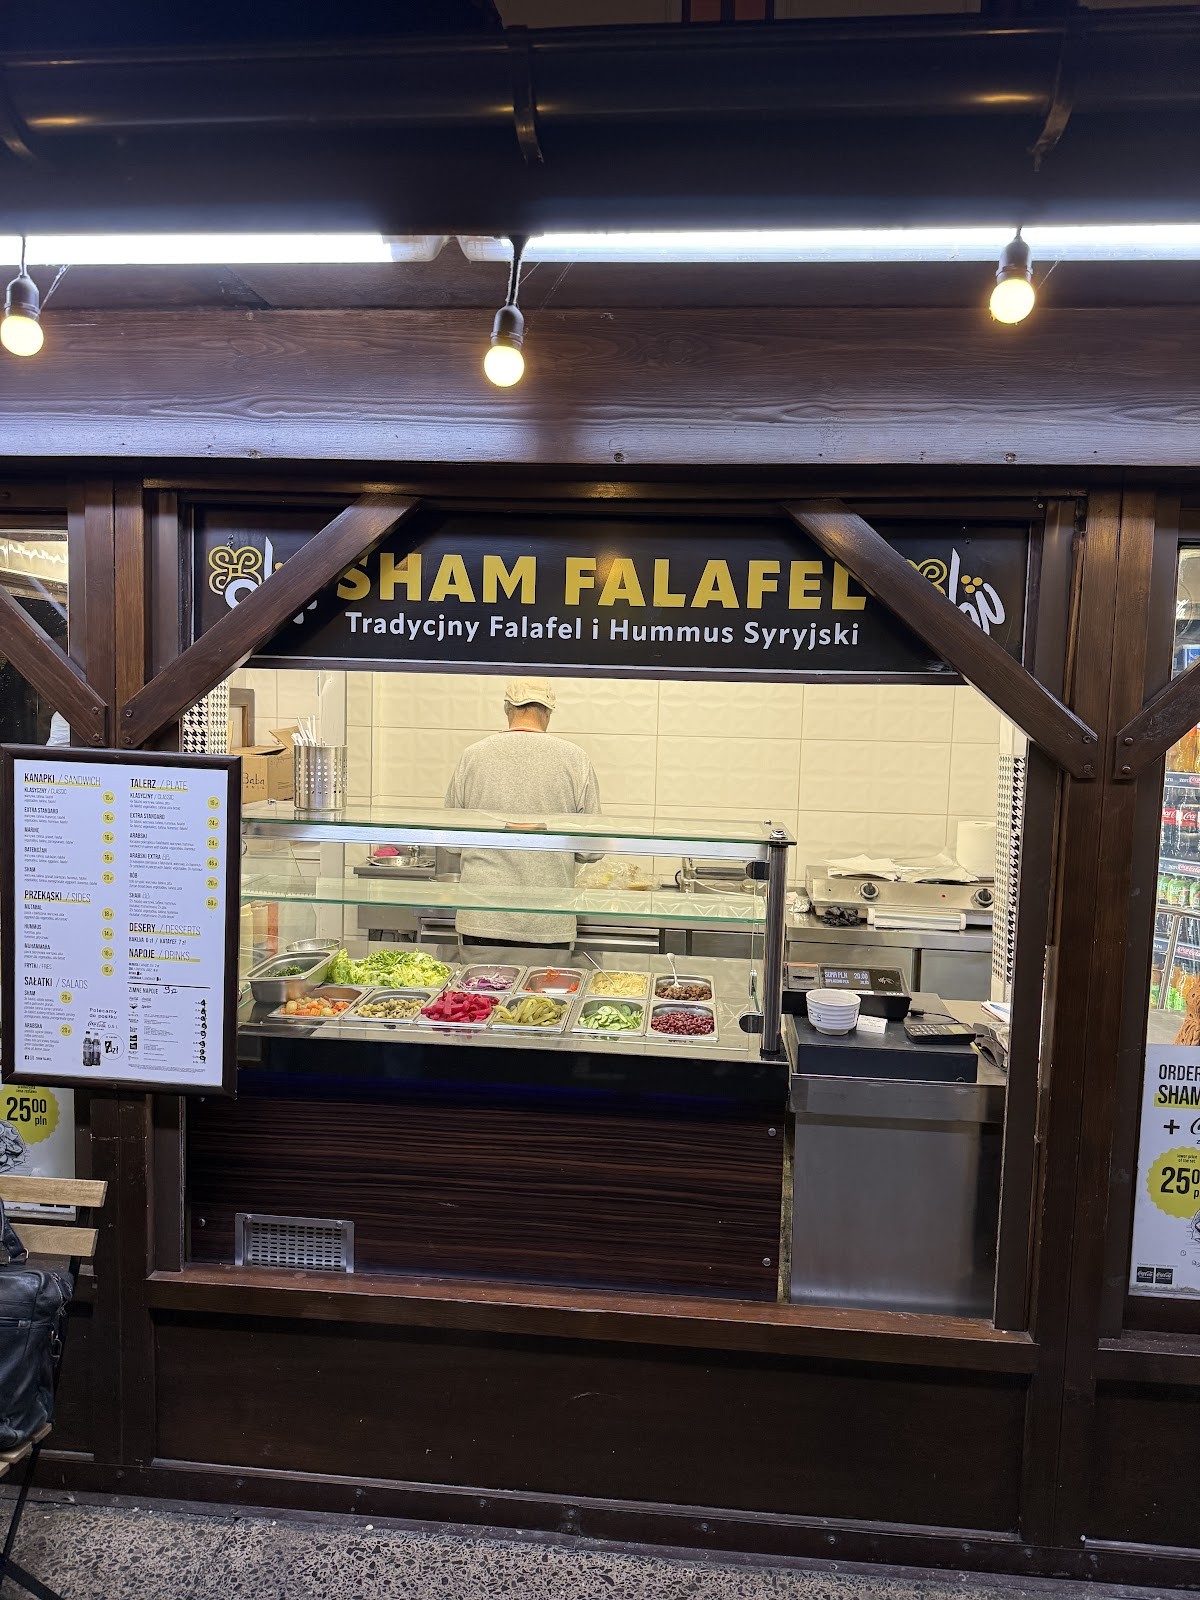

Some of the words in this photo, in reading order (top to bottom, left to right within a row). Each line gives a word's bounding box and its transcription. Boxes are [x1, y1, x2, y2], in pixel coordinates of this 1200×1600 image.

[337, 553, 536, 604] SHAM
[564, 556, 867, 611] FALAFEL
[345, 612, 479, 643] Tradycjny
[490, 615, 582, 640] Falafel
[591, 619, 599, 640] i
[609, 618, 734, 643] Hummus
[743, 622, 859, 651] Syryjski
[24, 772, 55, 784] KANAPKI
[64, 775, 101, 786] SANDWICH
[130, 778, 156, 788] TALERZ
[166, 780, 188, 790] PLATE
[24, 890, 62, 902] PRZEKĄSKI
[71, 893, 91, 903] SIDES
[129, 923, 156, 933] DESERY
[166, 925, 201, 936] DESSERTS
[129, 948, 155, 958] NAPOJE
[164, 950, 190, 960] DRINKS
[24, 976, 52, 987] SAŁATKI
[61, 978, 88, 989] SALADS
[35, 1115, 47, 1126] pln
